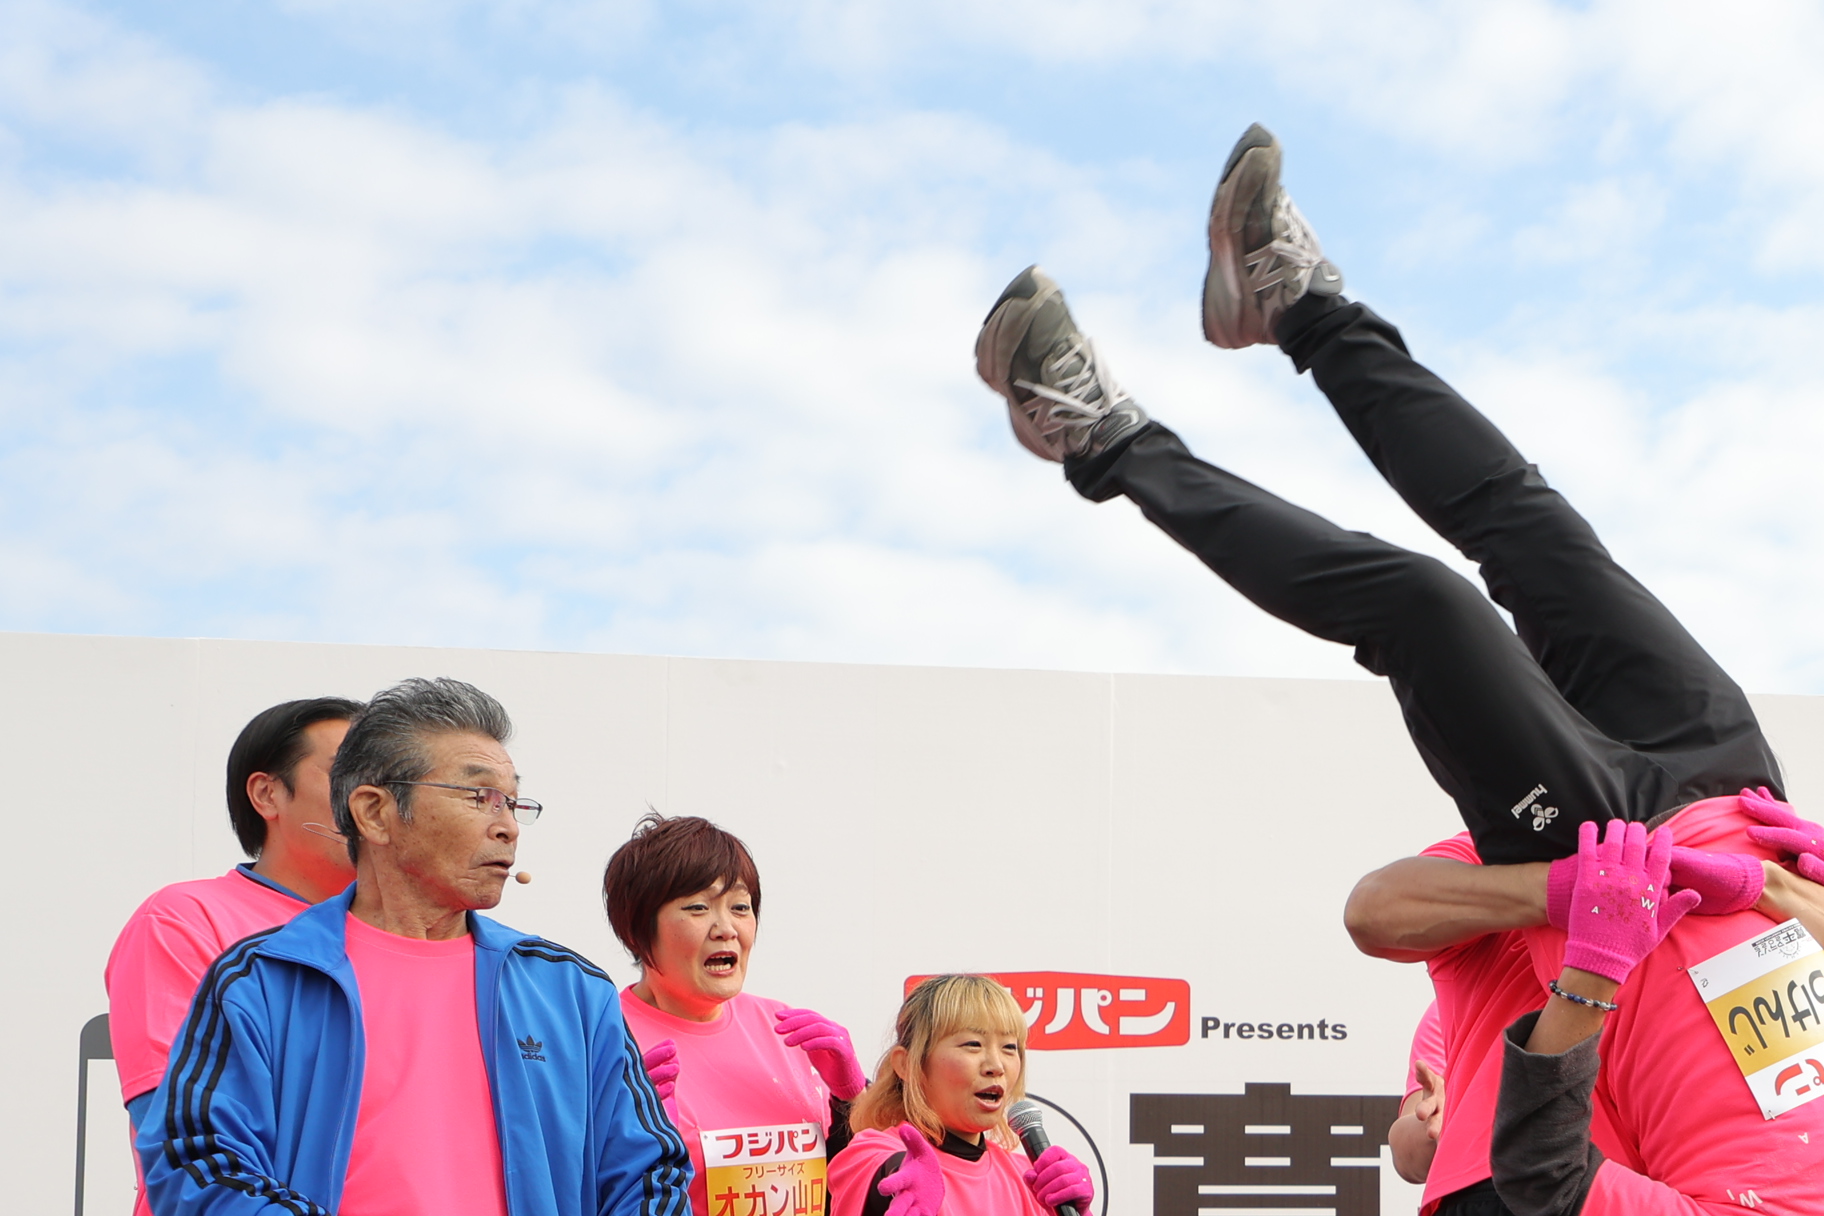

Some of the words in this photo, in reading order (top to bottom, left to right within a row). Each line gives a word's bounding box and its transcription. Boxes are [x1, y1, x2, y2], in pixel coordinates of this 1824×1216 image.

[1511, 783, 1548, 819] hummel
[1201, 1016, 1348, 1041] Presents
[715, 1128, 818, 1159] フジパン
[743, 1162, 805, 1179] フリーサイズ
